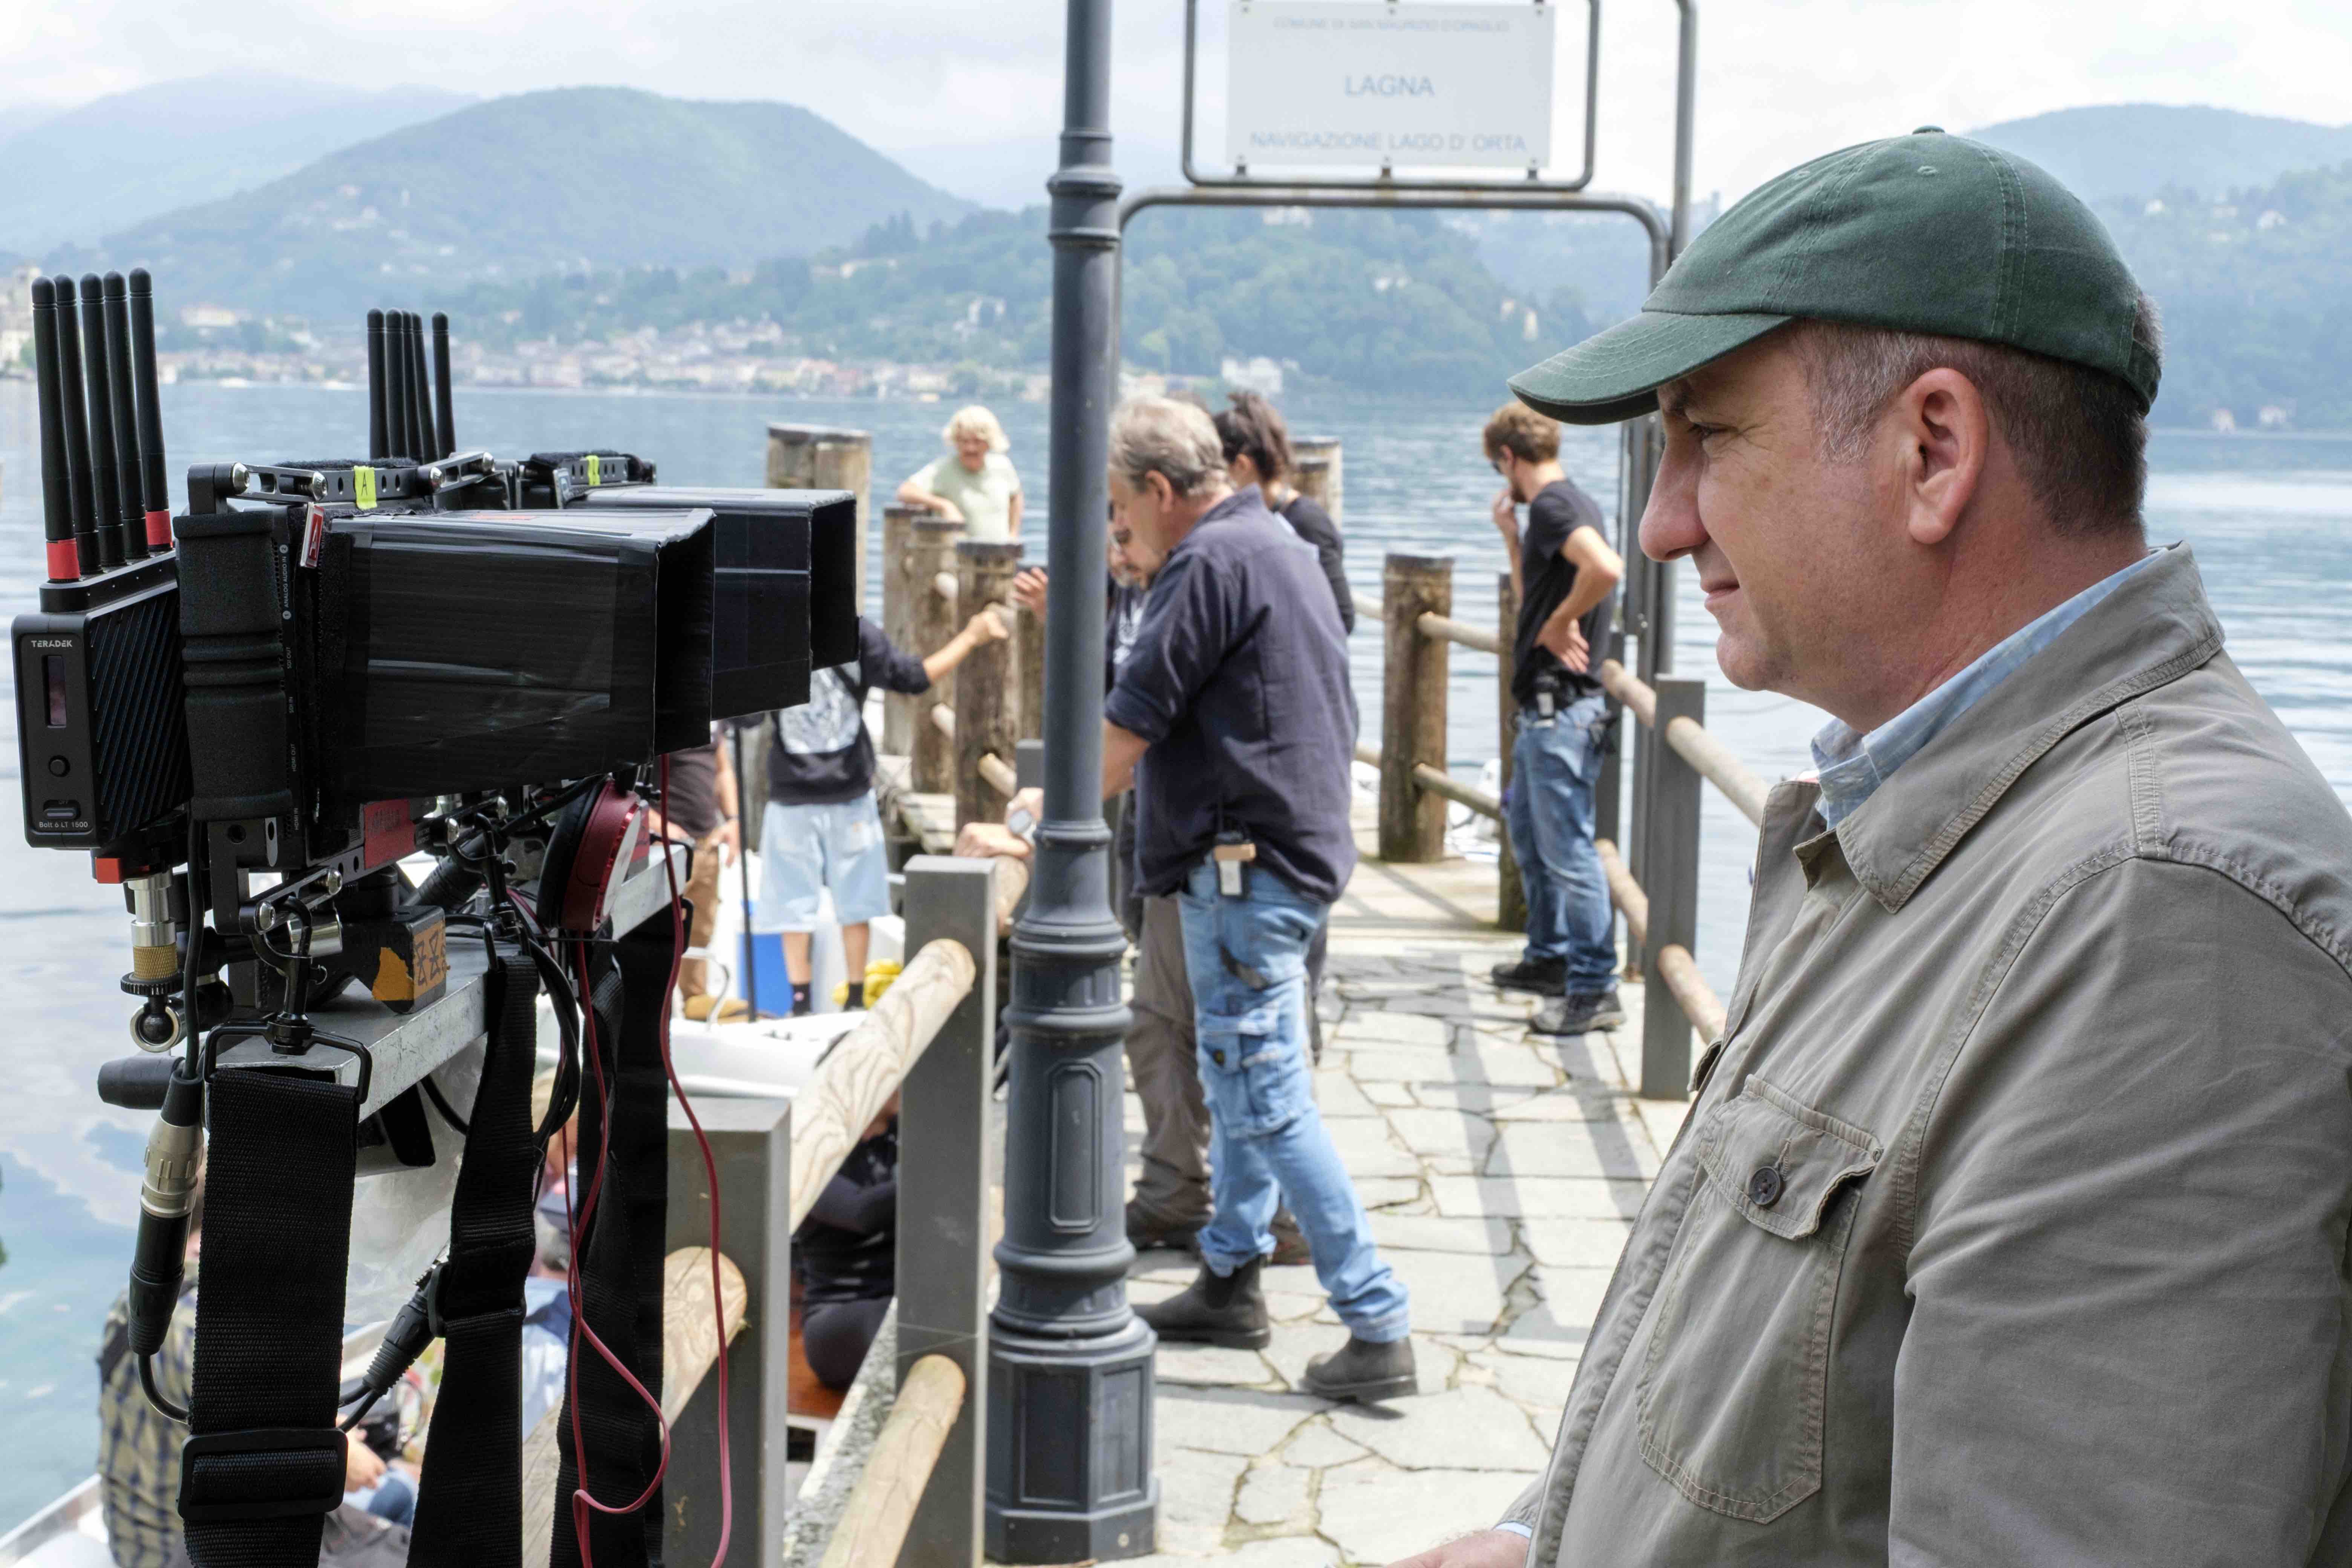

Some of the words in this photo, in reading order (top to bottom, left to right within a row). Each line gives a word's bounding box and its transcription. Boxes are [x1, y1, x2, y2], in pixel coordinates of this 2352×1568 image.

[1344, 75, 1435, 97] LAGNA
[1250, 132, 1381, 150] NAVIGAZIONE
[1389, 134, 1444, 151] LAGO
[1472, 135, 1527, 152] ORTA
[361, 471, 368, 496] A
[309, 519, 319, 559] A
